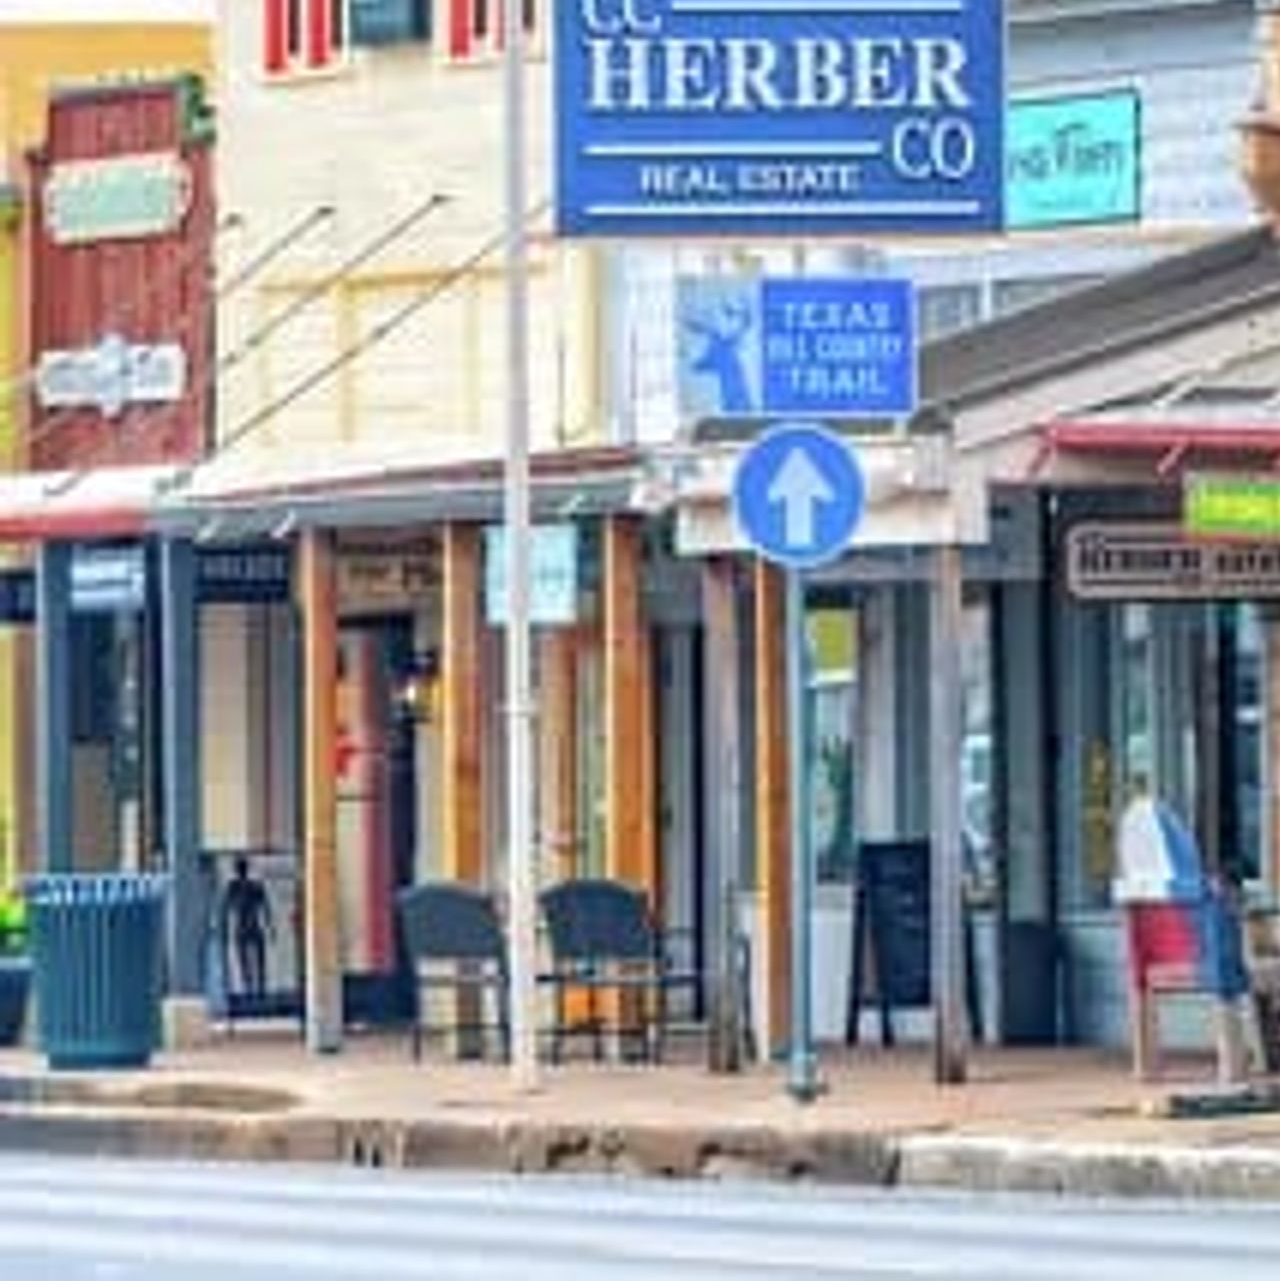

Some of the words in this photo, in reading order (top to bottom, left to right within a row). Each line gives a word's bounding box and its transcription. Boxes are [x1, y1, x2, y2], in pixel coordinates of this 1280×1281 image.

[582, 37, 973, 110] HERBER
[891, 117, 975, 178] CO
[639, 166, 726, 192] REAL
[737, 165, 862, 191] ESTATE
[782, 302, 890, 329] TEXAS
[784, 366, 889, 395] TRAIL
